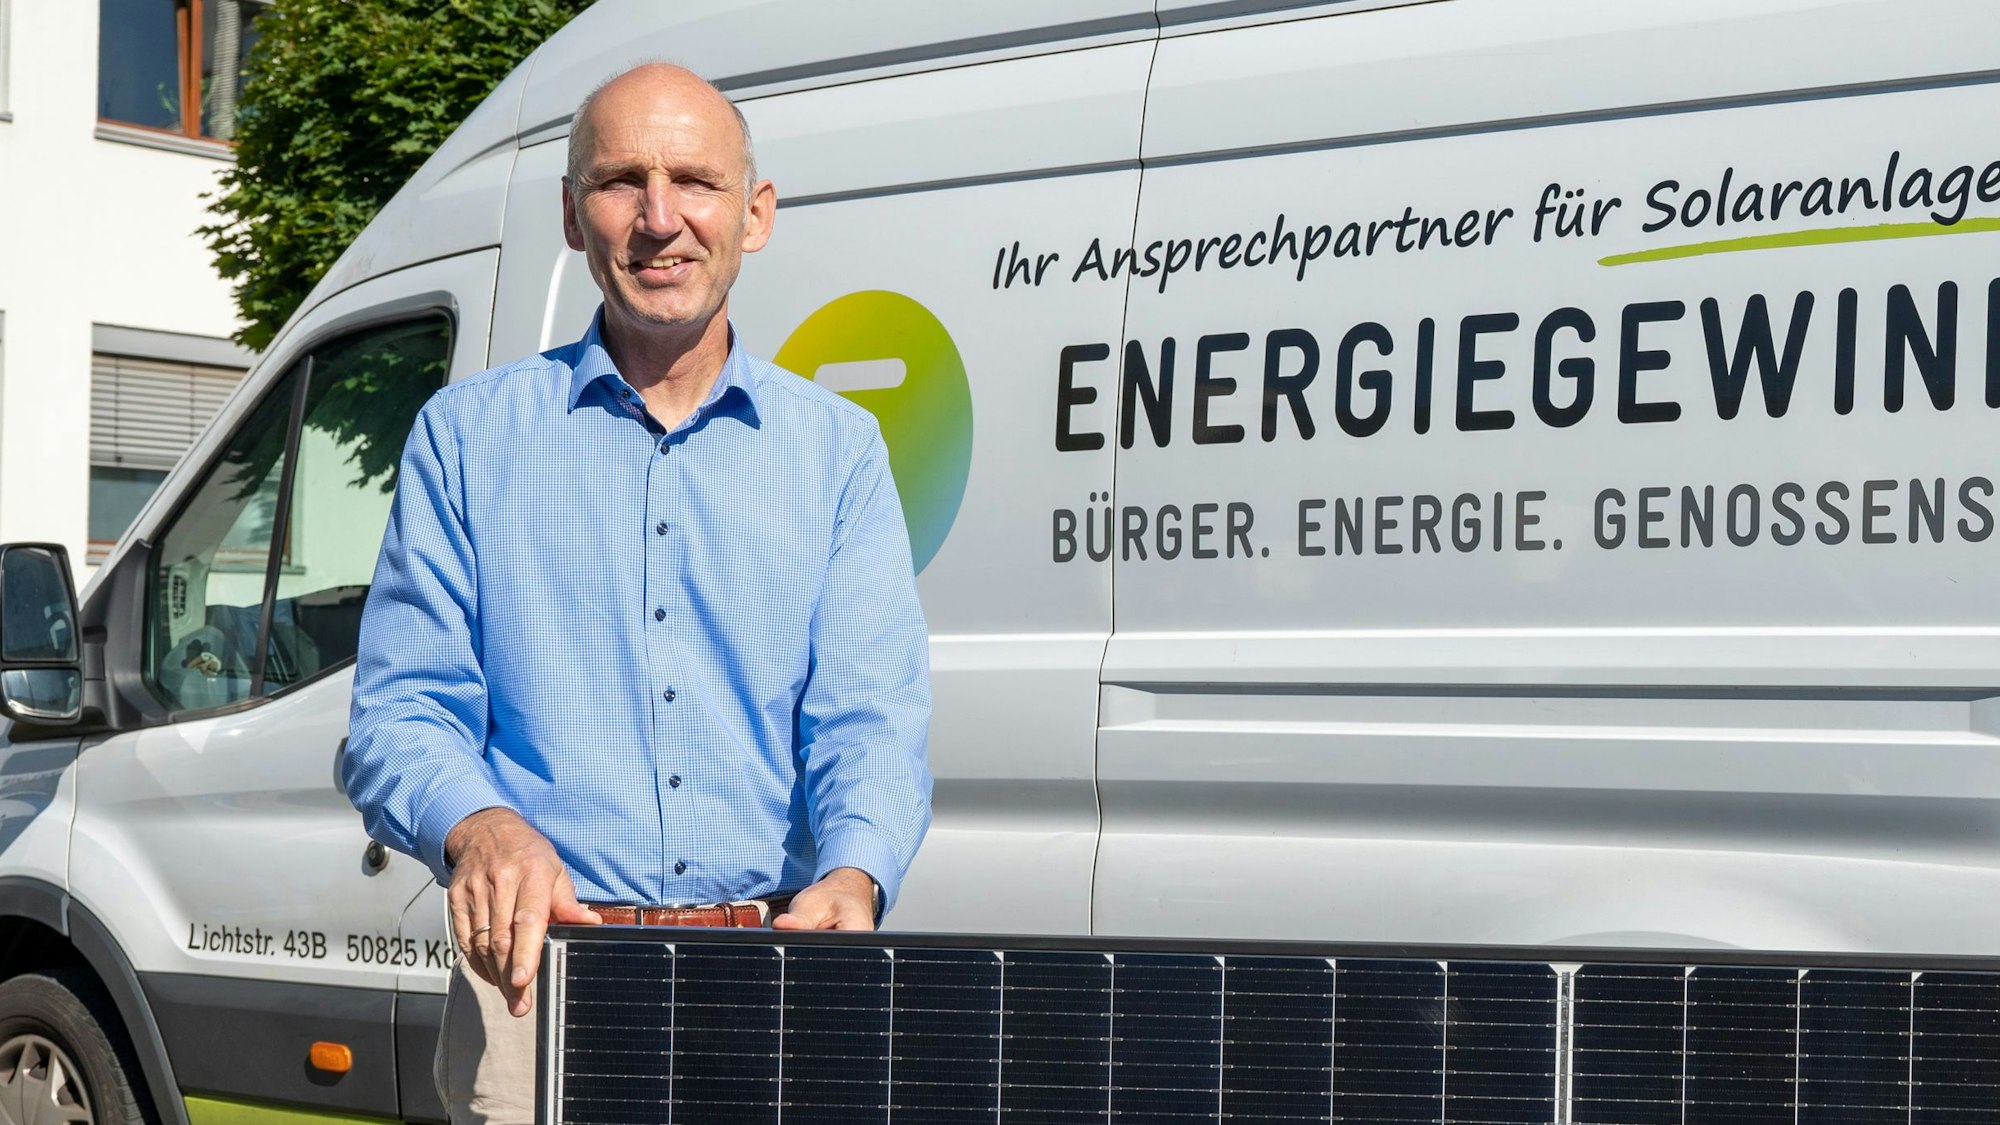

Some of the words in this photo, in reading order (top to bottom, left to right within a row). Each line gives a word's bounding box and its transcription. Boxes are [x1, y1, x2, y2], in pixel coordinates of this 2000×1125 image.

[992, 240, 1060, 290] Ihr
[1071, 206, 1514, 294] Ansprechpartner
[1533, 182, 1622, 243] für
[1641, 150, 2000, 227] Solaranlage
[1055, 276, 2000, 453] ENERGIEGEWIN
[1052, 491, 1271, 563] BÜRGER.
[1298, 490, 1564, 558] ENERGIE.
[1594, 476, 1996, 550] GENOSSENS
[187, 922, 275, 956] Lichtstr.
[283, 929, 328, 960] 43B
[346, 933, 418, 968] 50825
